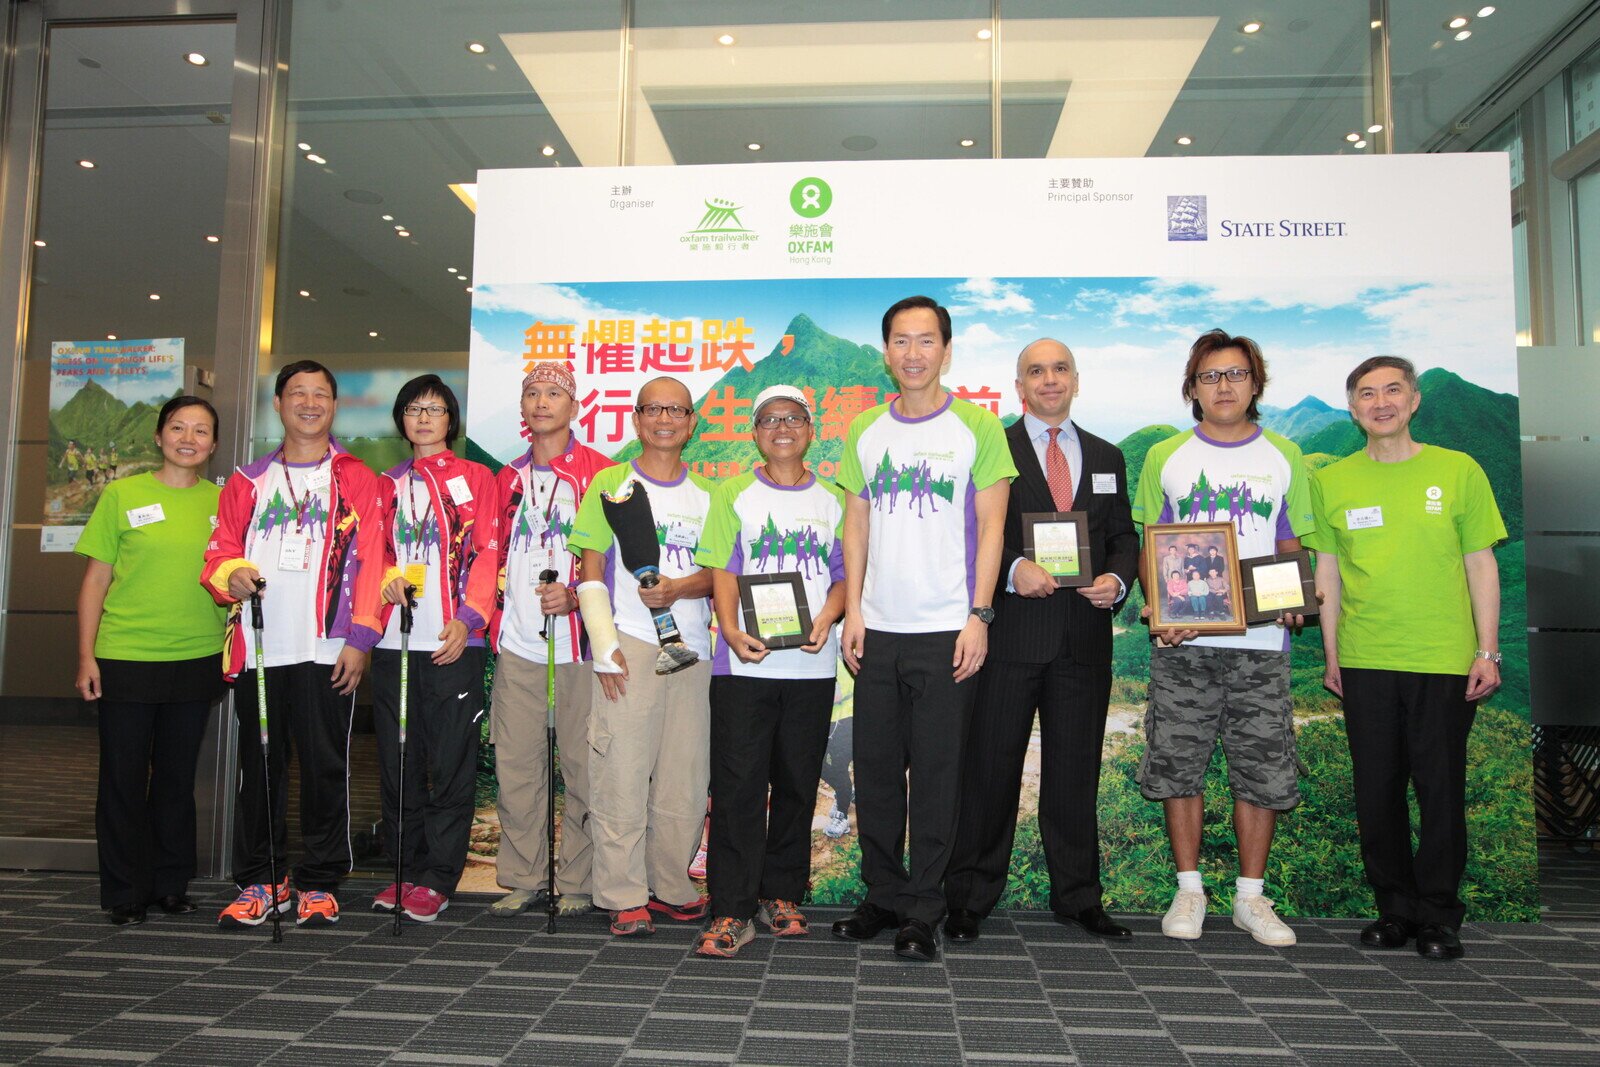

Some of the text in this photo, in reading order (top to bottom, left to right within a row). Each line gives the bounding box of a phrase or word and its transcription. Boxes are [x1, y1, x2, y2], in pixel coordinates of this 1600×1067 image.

[1048, 177, 1094, 189] 主要贊助
[611, 185, 632, 196] 主辦
[1048, 191, 1134, 204] Principal Sponsor
[610, 199, 655, 210] Organiser
[789, 223, 834, 239] 樂施會
[1221, 219, 1347, 238] STATE STREET
[679, 233, 759, 243] oxfam trailwalker
[788, 241, 834, 254] OXFAM
[789, 256, 832, 266] Hong Kong
[257, 654, 265, 679] oxfam
